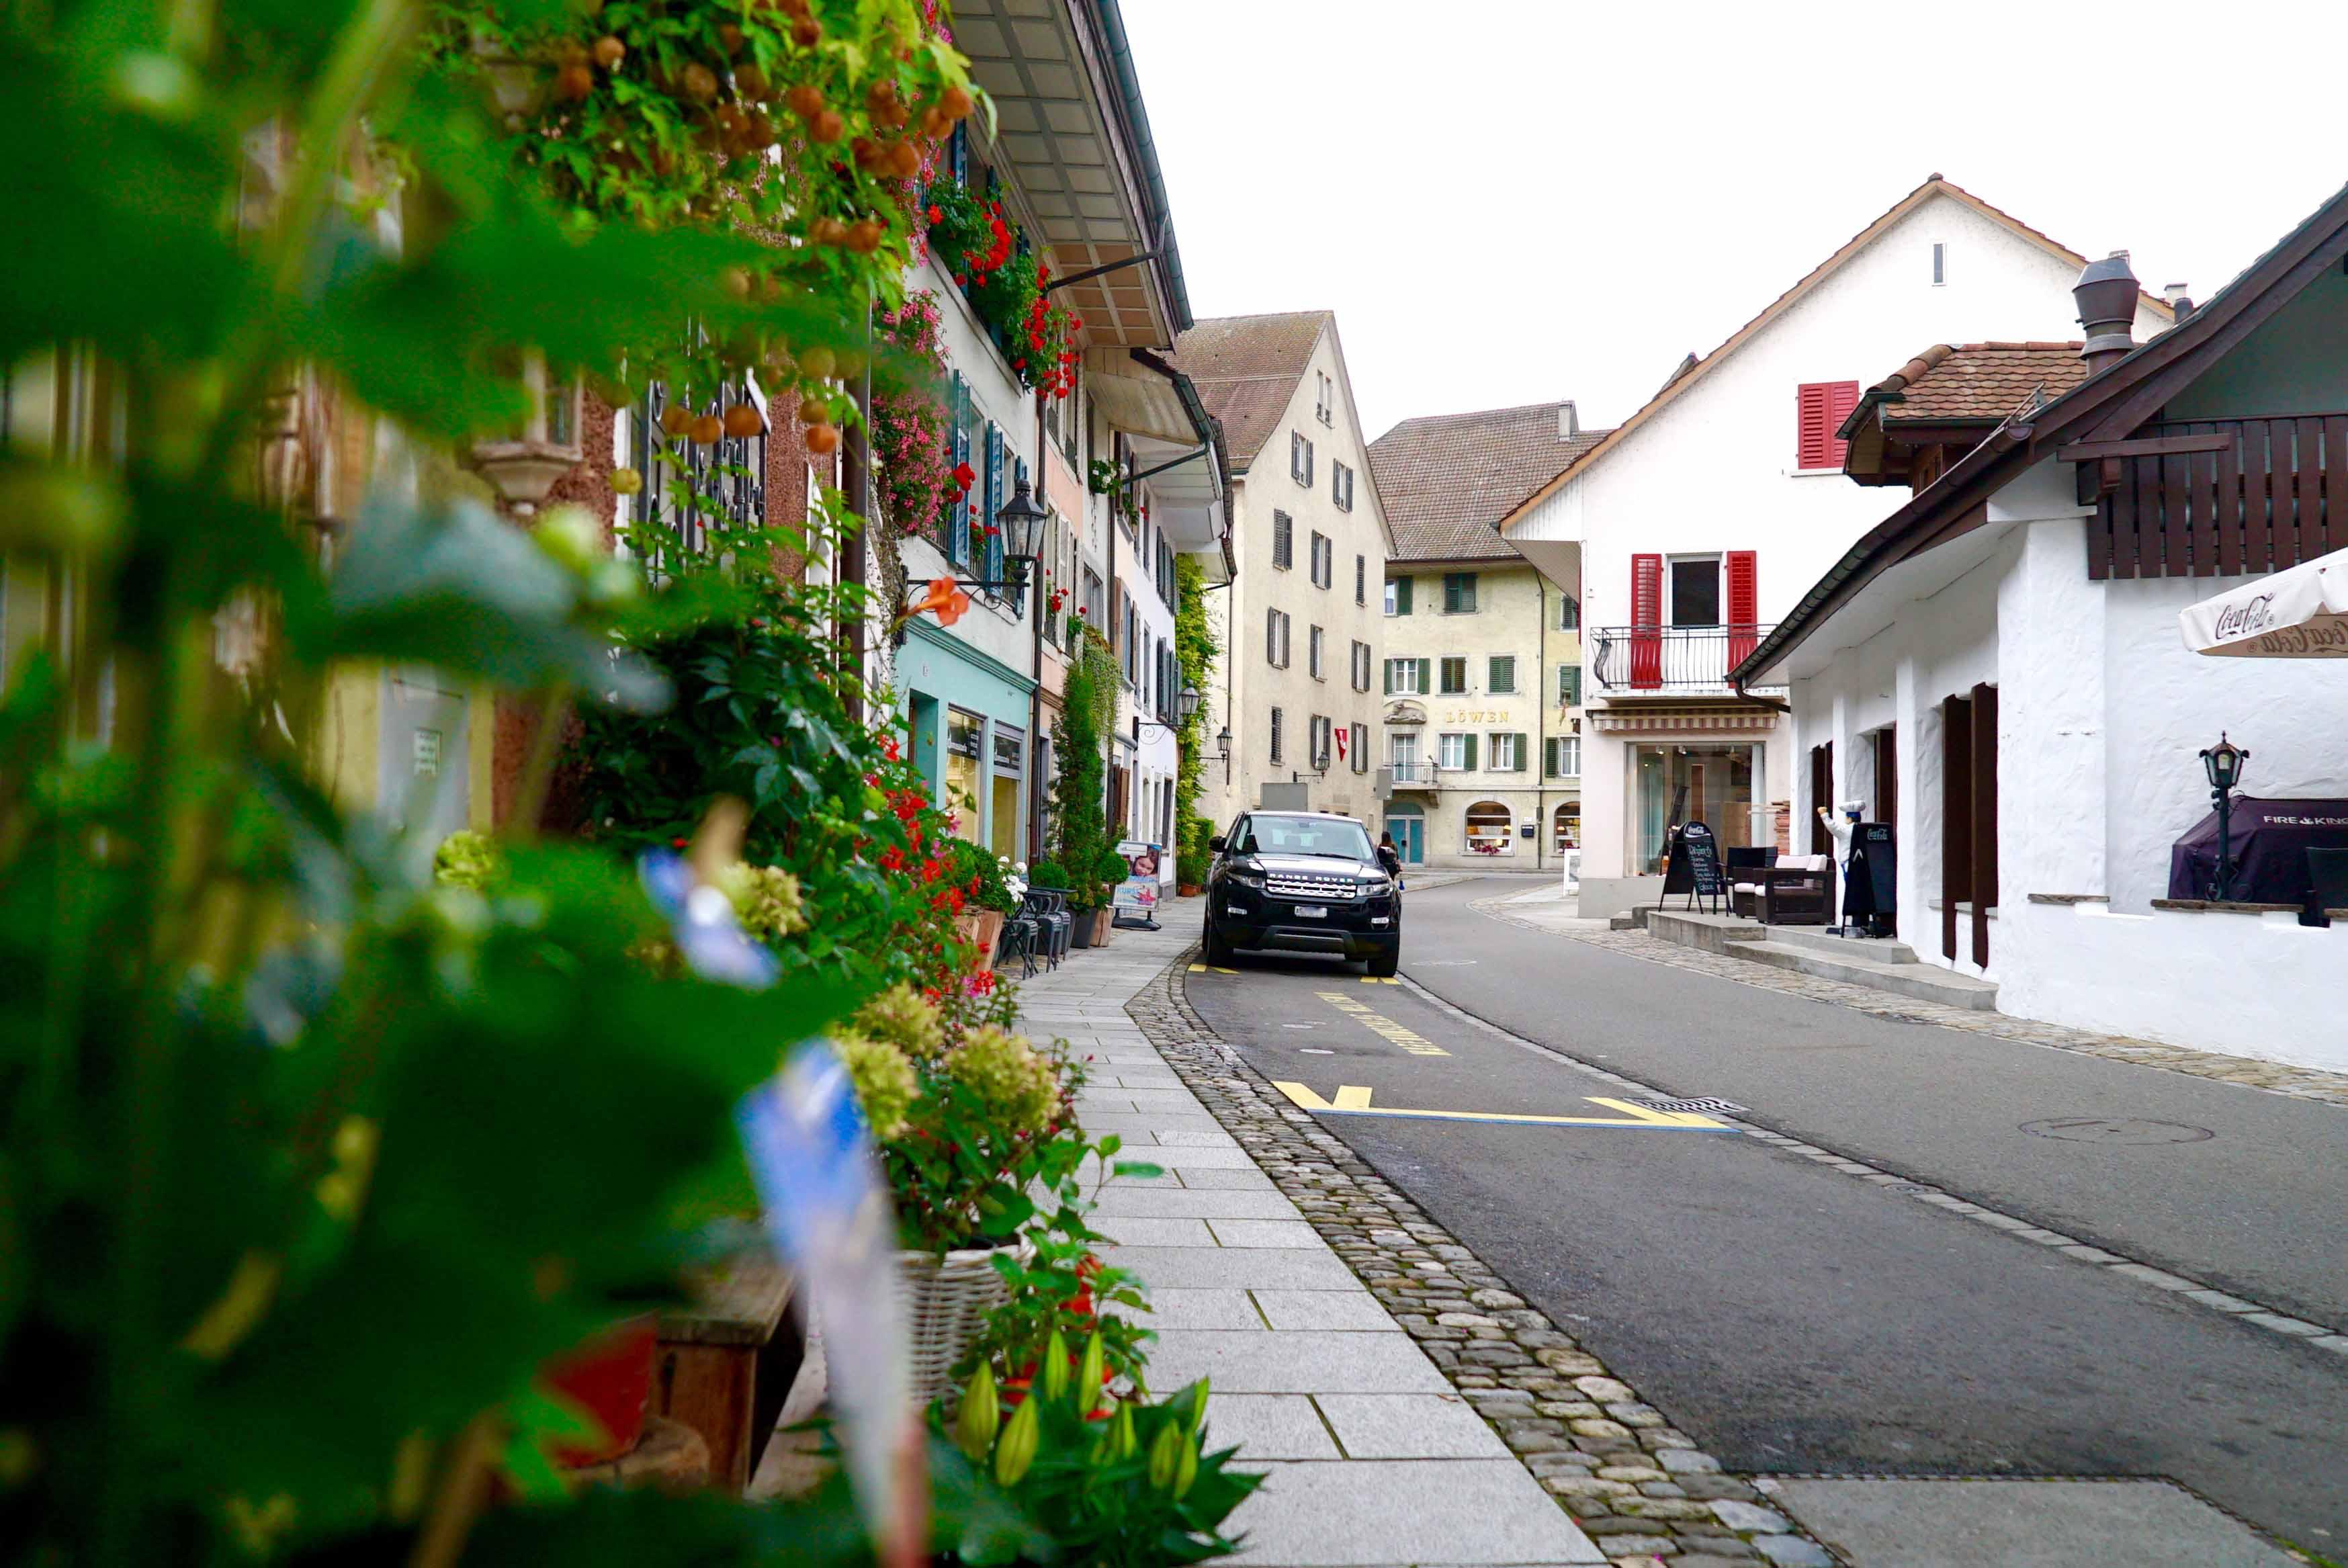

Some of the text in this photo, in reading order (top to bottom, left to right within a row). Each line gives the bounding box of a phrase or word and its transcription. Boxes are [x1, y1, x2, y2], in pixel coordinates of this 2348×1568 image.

[1446, 709, 1509, 724] LÖWEN
[2263, 815, 2298, 824] FIRE
[1269, 873, 1309, 881] RANGE
